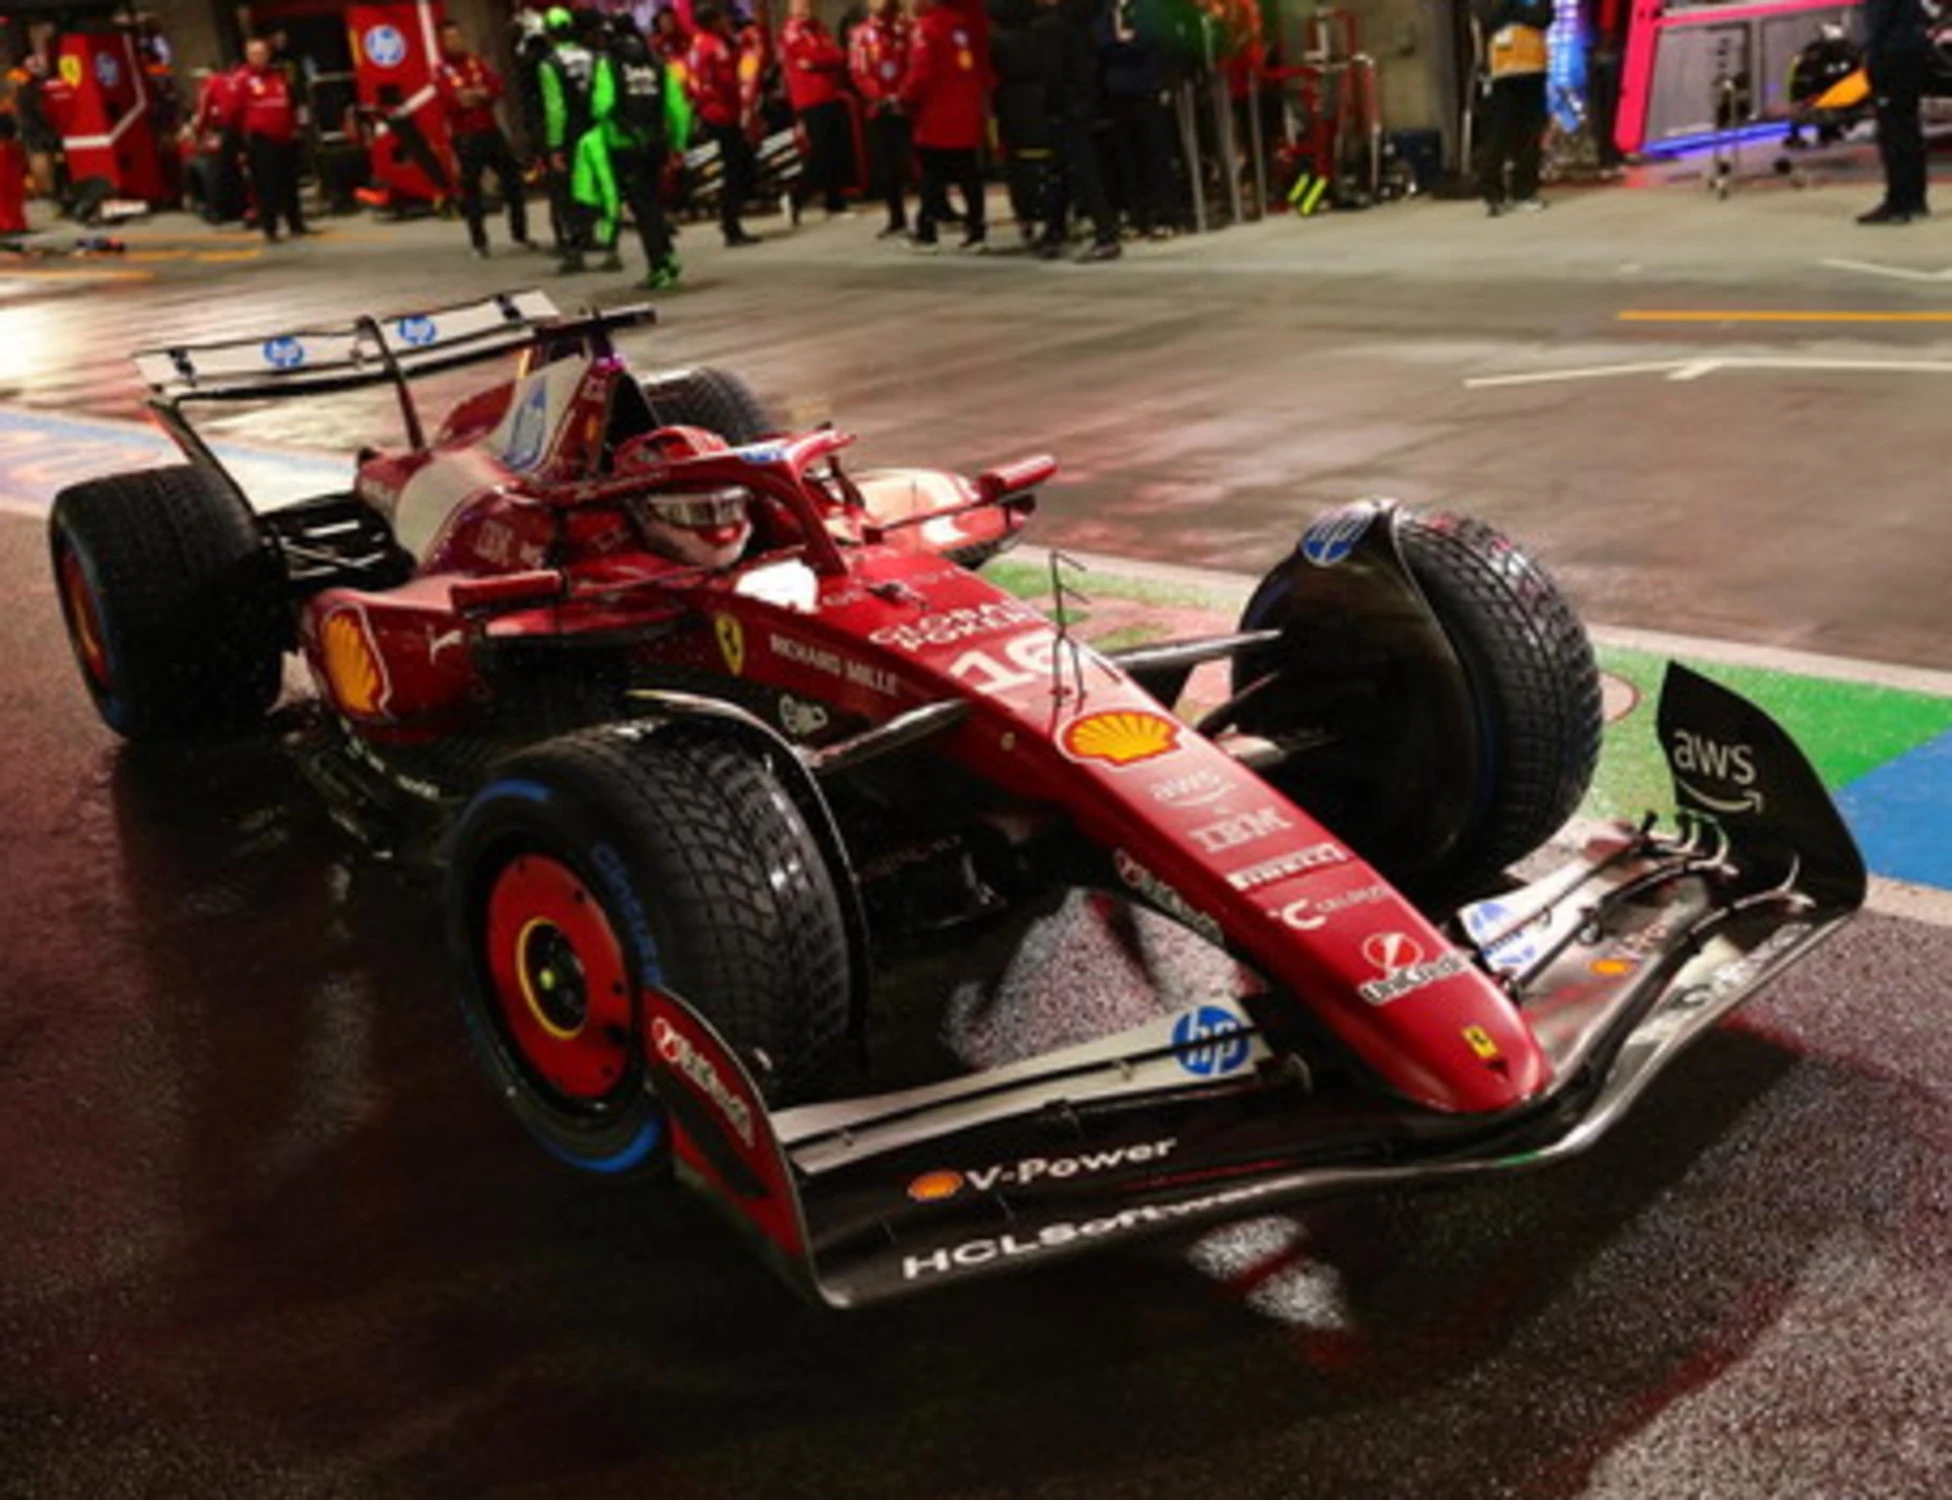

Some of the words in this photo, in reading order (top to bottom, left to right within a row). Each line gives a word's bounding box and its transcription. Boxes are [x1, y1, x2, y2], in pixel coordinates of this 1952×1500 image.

[948, 631, 1073, 695] 16
[1673, 728, 1759, 787] aws
[1188, 805, 1294, 854] IBM
[1187, 1006, 1243, 1075] hp
[966, 1136, 1178, 1191] V-Power
